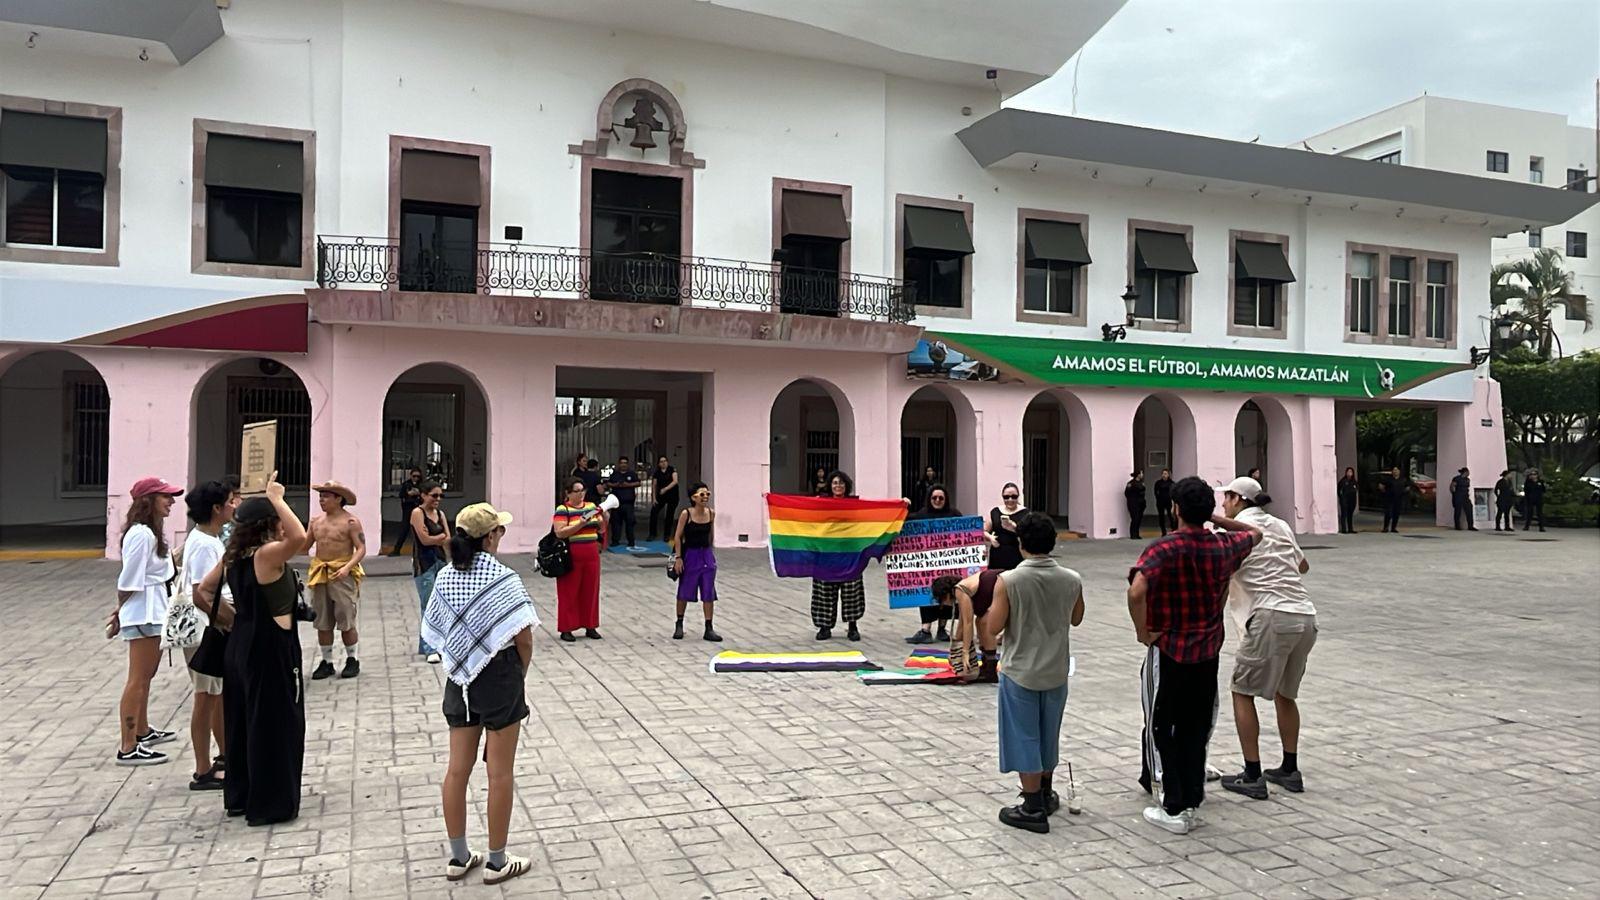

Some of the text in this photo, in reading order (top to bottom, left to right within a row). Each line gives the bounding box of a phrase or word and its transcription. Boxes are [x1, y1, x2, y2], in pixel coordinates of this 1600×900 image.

[1052, 355, 1349, 383] AMAMOS EL FÚTBOL, AMAMOS MAZATLÁN
[886, 553, 929, 563] PROPAGANDA
[972, 546, 980, 554] DE
[888, 578, 923, 587] VIOLENCIA
